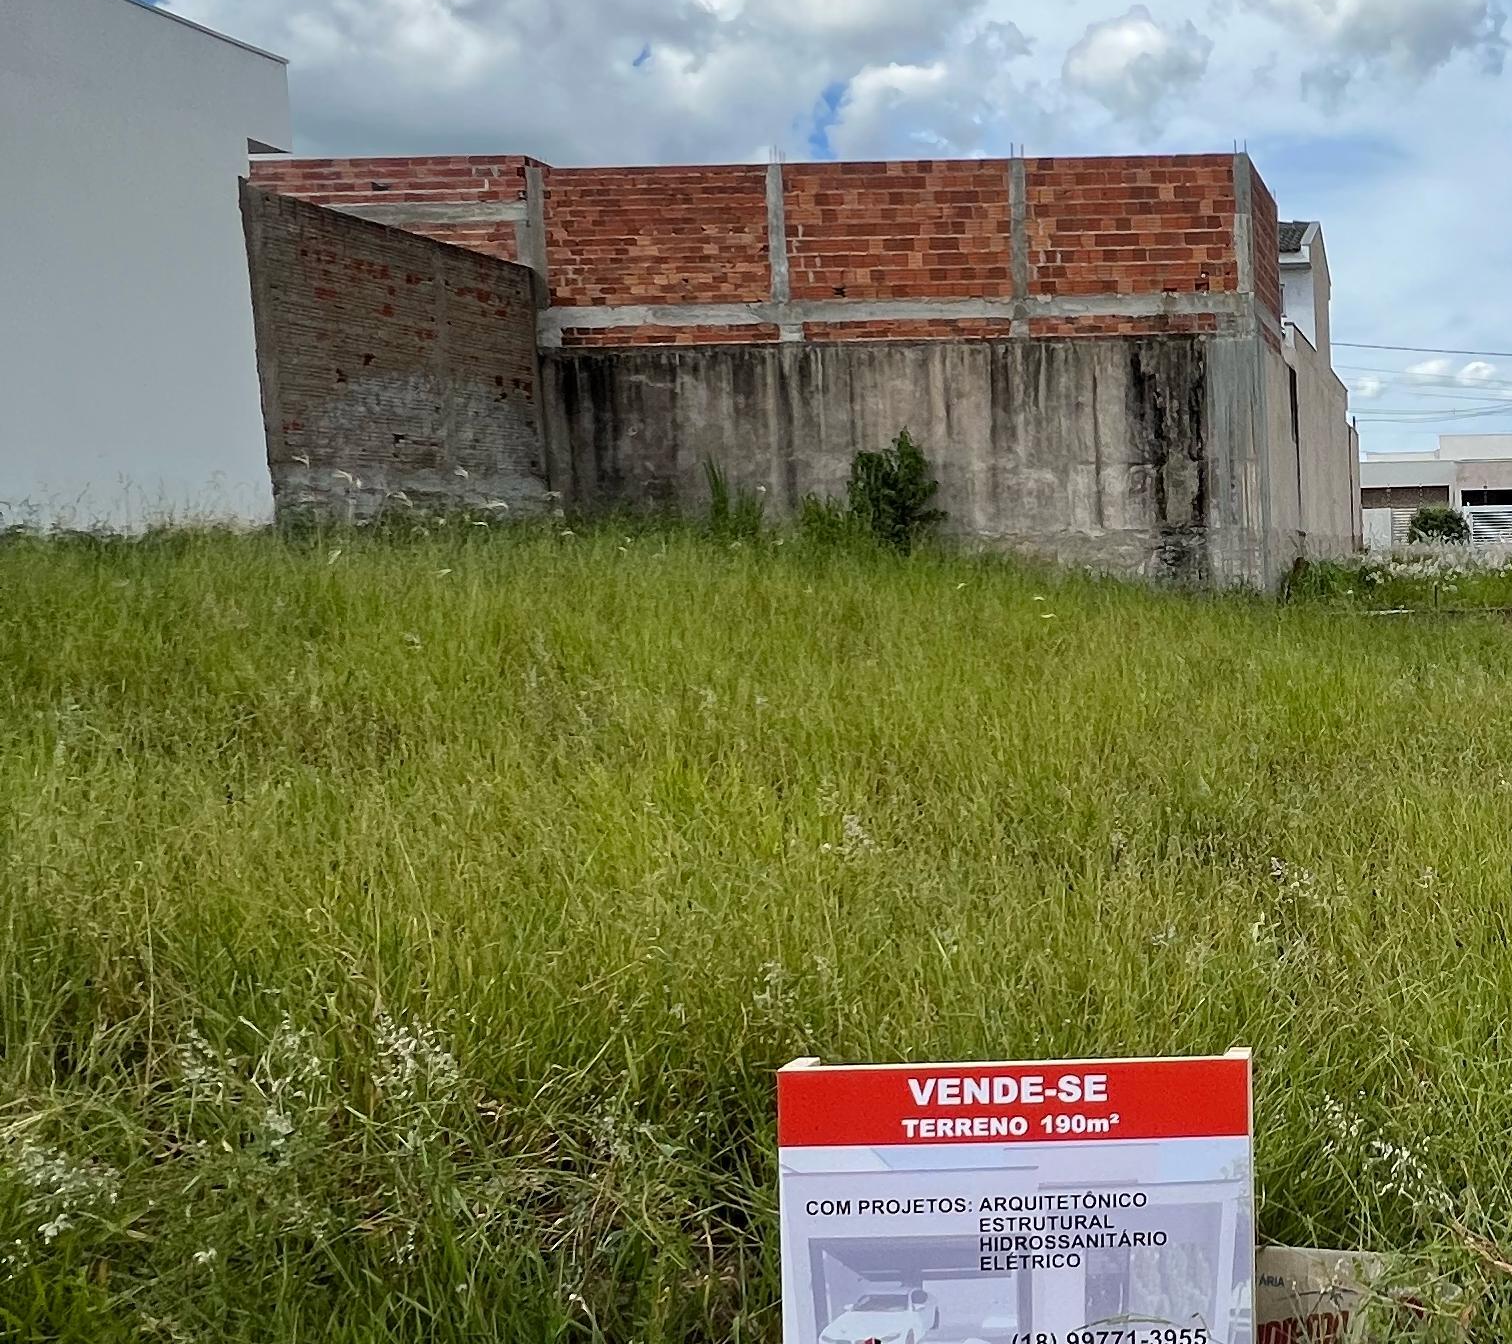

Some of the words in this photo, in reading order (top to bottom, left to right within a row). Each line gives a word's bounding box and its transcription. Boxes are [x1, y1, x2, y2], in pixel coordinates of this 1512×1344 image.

[908, 1074, 1108, 1105] VENDE-SE
[901, 1116, 1028, 1138] TERRENO
[1040, 1113, 1120, 1134] 190m²
[806, 1200, 851, 1216] COM
[858, 1197, 973, 1215] PROJETOS:
[979, 1191, 1147, 1212] ARQUITETÔNICO
[980, 1214, 1115, 1233] ESTRUTURAL
[980, 1230, 1168, 1252] HIDROSSANITÁRIO
[980, 1250, 1081, 1271] ELÉTRICO
